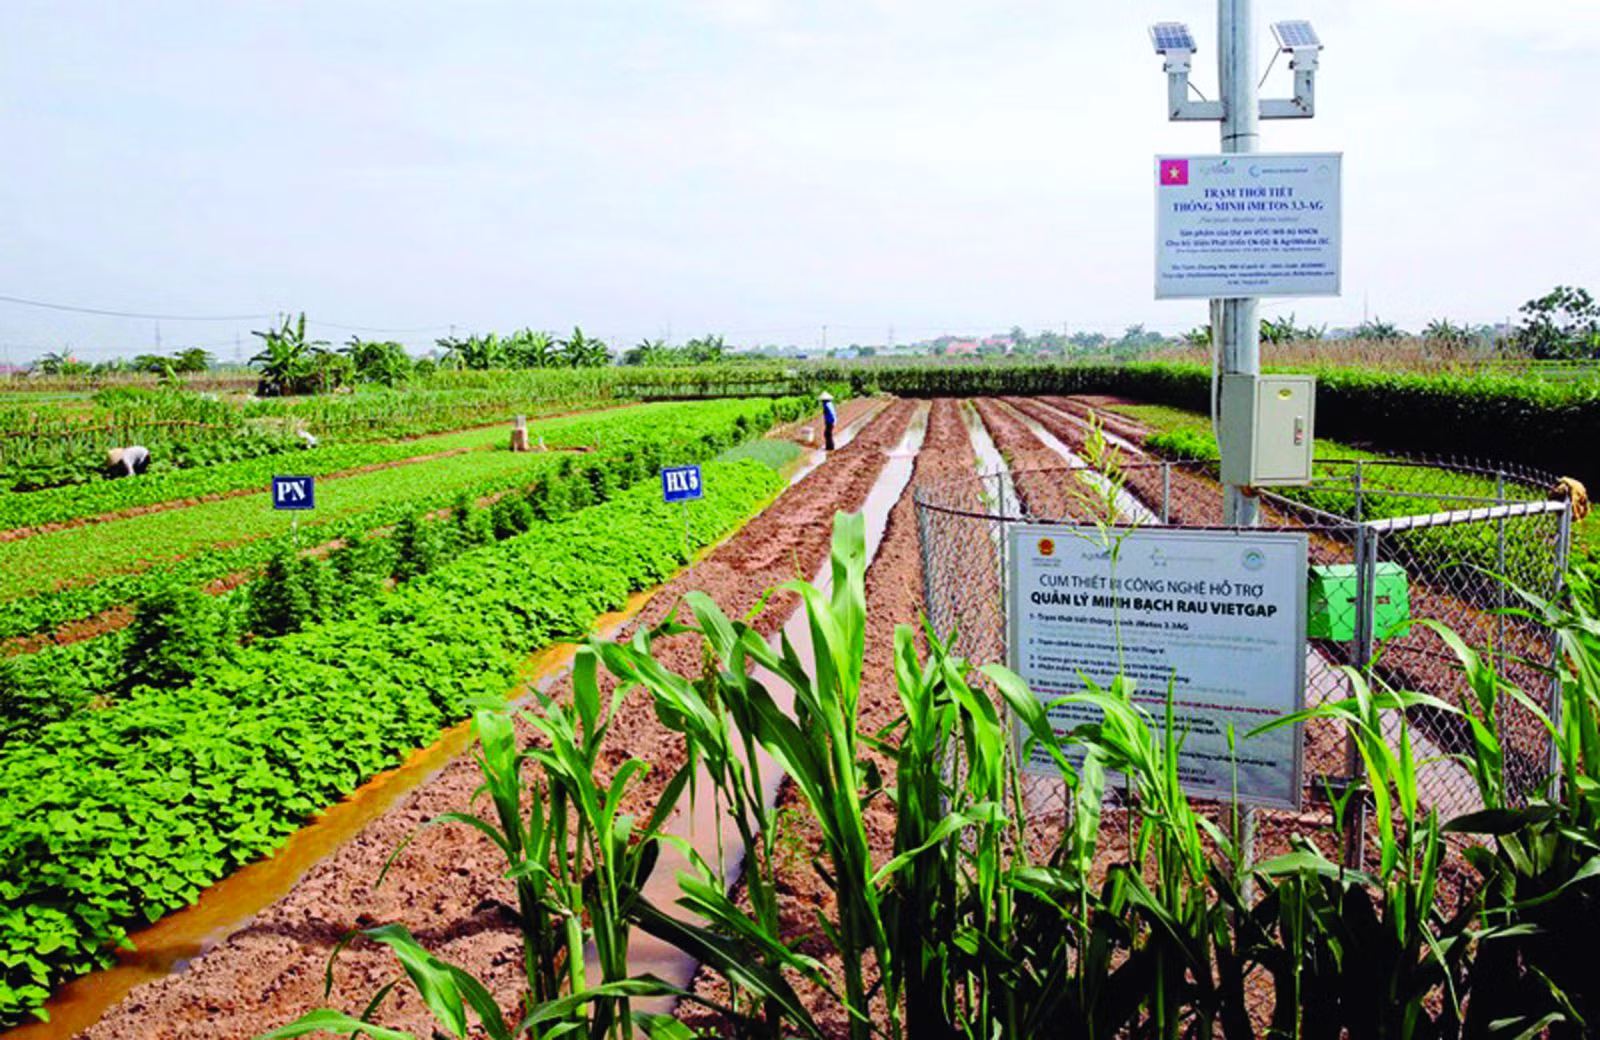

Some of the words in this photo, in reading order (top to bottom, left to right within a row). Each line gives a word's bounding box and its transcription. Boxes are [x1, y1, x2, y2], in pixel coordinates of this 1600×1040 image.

[1216, 201, 1245, 211] MINH
[276, 480, 306, 502] PN
[1124, 577, 1165, 593] CÔNG
[1091, 595, 1131, 609] MINH
[1133, 597, 1174, 615] BẠCH
[1176, 599, 1208, 614] RAU
[1210, 601, 1278, 618] VIETGAP
